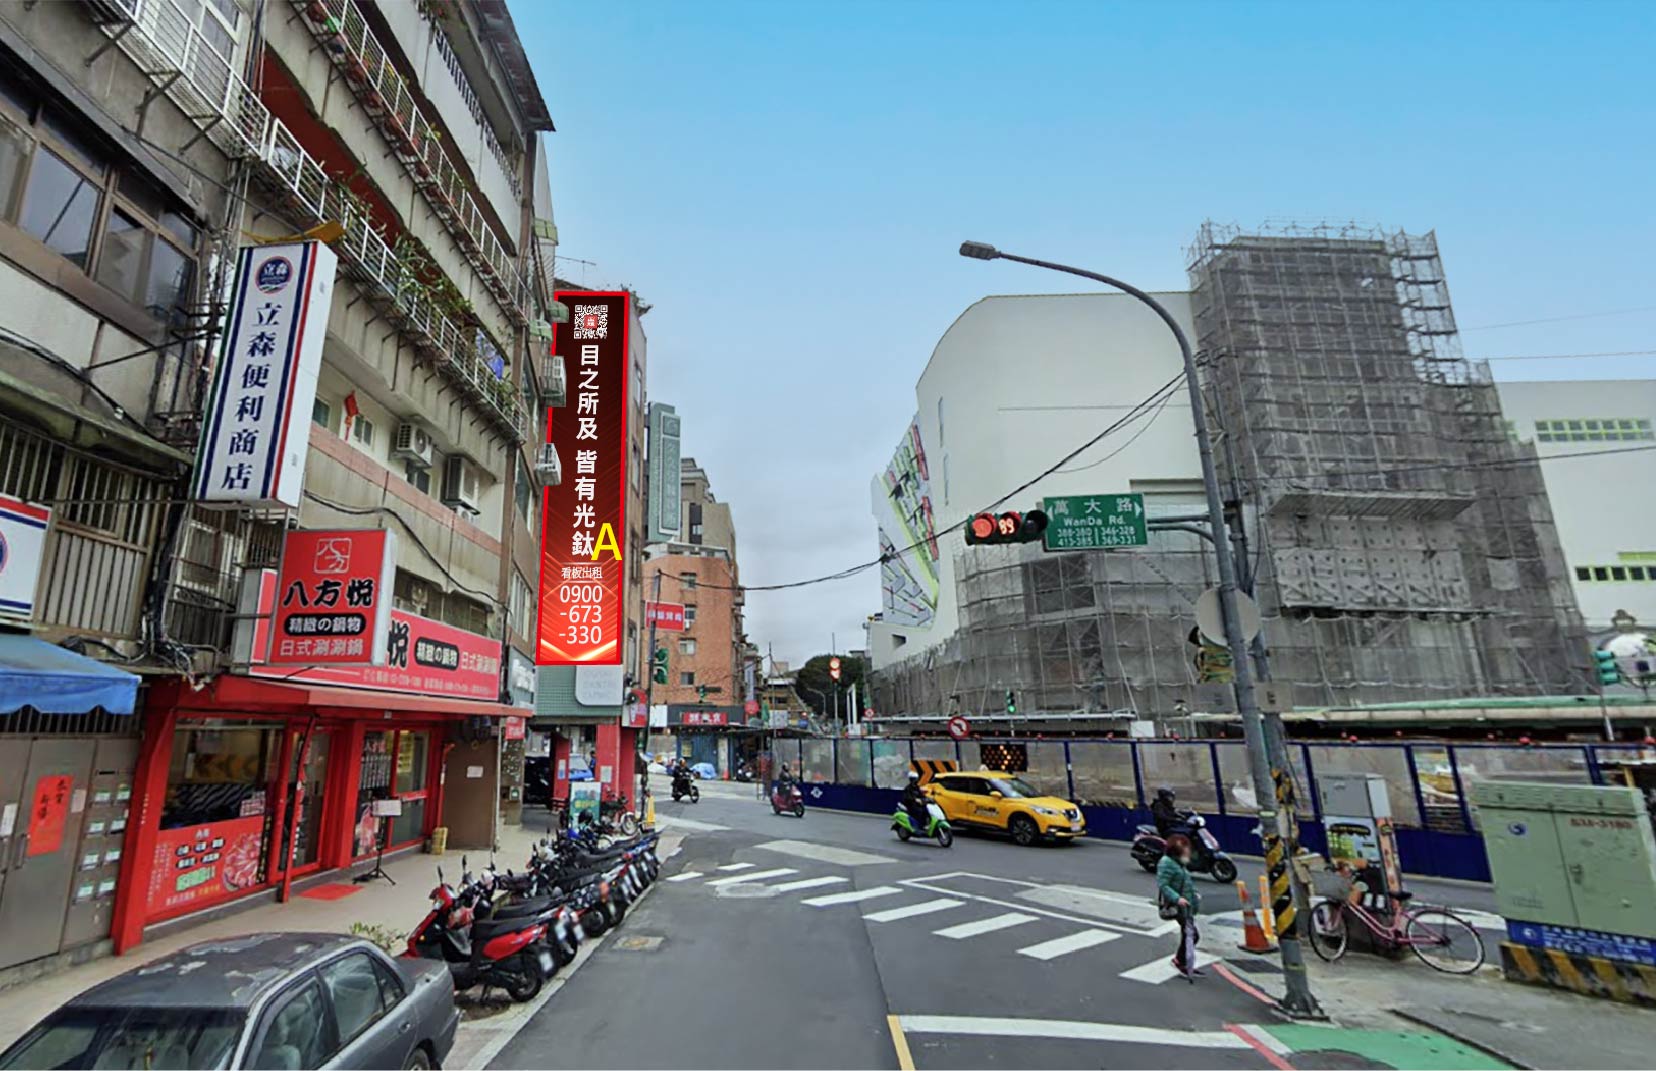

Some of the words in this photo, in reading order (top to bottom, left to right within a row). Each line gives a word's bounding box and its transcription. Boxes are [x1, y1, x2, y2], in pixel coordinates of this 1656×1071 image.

[222, 302, 282, 491] 立森便利商店
[576, 344, 600, 441] 目之所及
[1054, 497, 1133, 515] 萬大路
[1063, 516, 1102, 527] WanDa
[1108, 514, 1126, 525] Rd.
[561, 566, 602, 580] 看板出租
[559, 585, 603, 604] 0900
[559, 605, 602, 623] -673
[558, 625, 602, 645] -330
